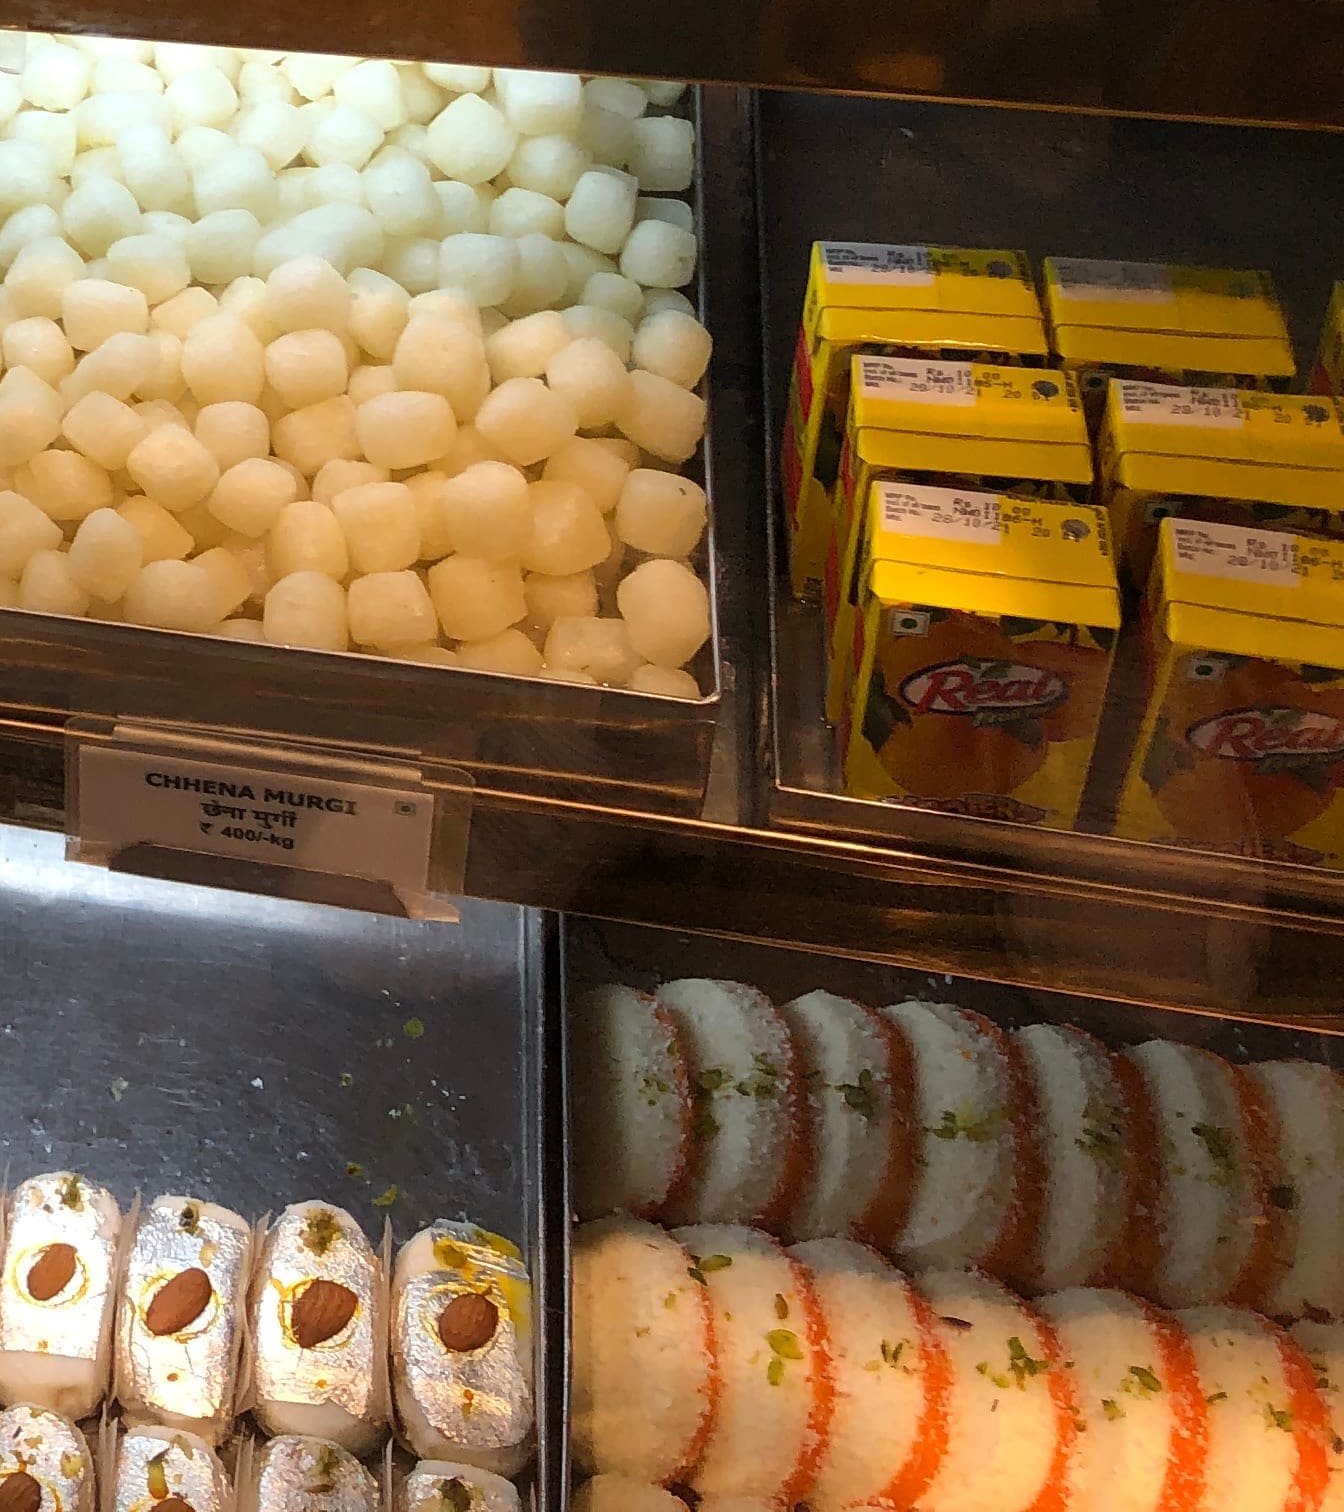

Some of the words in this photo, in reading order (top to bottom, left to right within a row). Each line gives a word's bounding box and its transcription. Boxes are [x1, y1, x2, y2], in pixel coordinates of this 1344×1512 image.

[914, 669, 1054, 716] Real
[145, 772, 256, 801] CHHENA
[263, 789, 358, 816] MURGI
